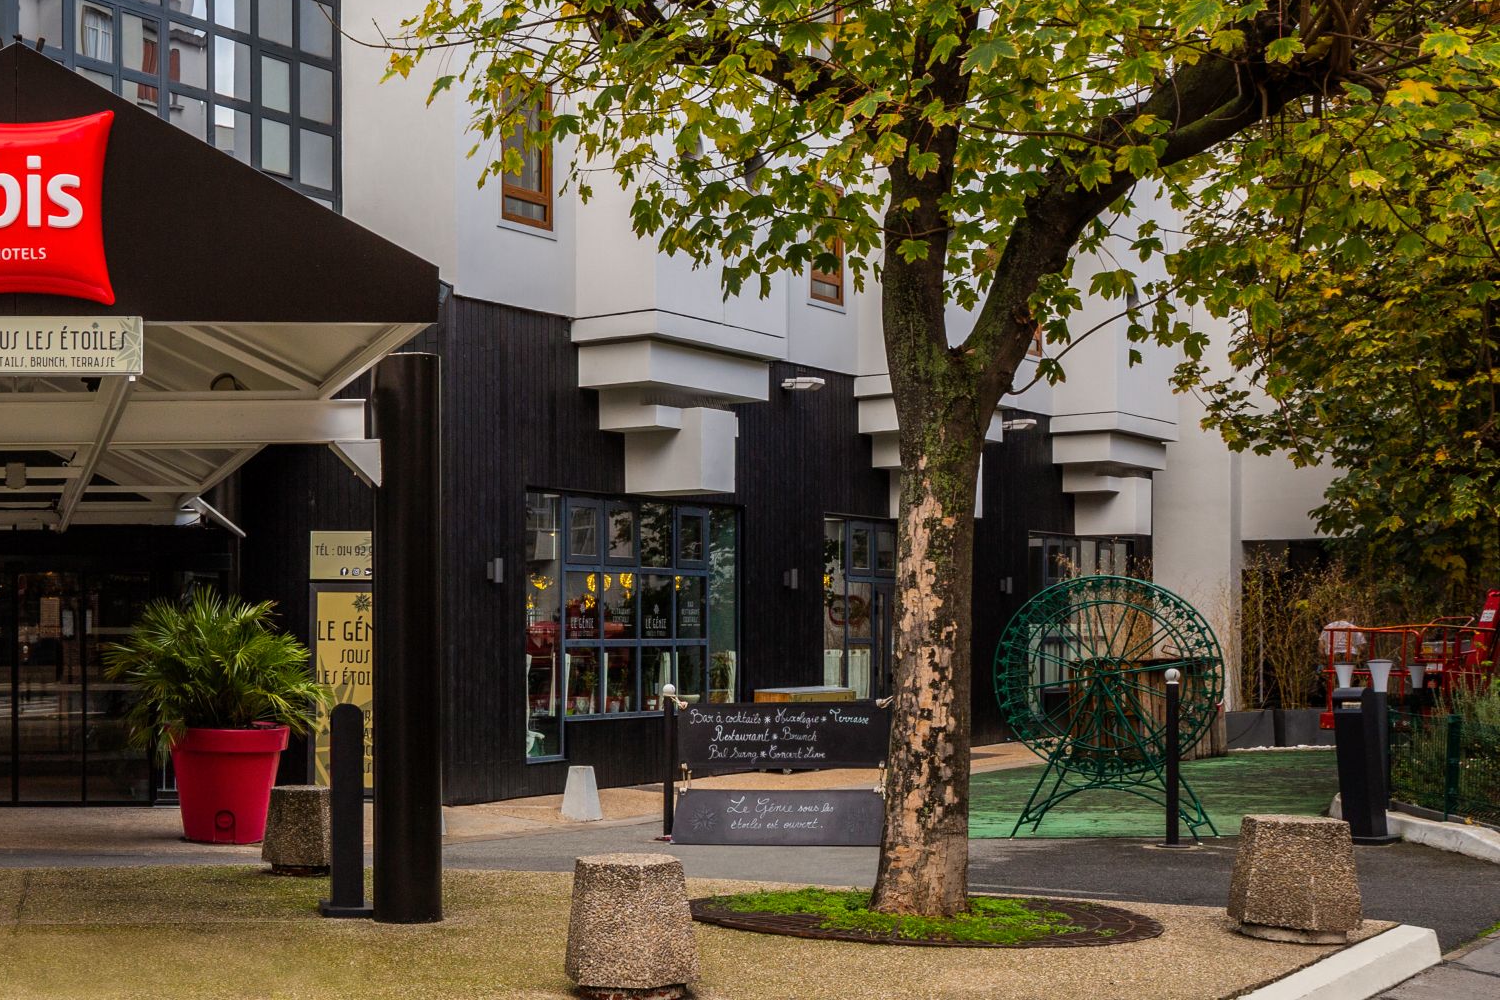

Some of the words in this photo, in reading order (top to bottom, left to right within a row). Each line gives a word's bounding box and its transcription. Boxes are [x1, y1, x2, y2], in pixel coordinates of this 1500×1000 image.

[26, 330, 53, 350] LES
[60, 325, 128, 350] ÉTOILES
[30, 356, 68, 368] BRUNCH,
[71, 356, 116, 368] TERRASSE
[315, 542, 329, 556] TÉL
[337, 546, 352, 556] 014
[318, 620, 336, 641] LE
[343, 616, 373, 641] GÉN
[340, 649, 370, 664] SOUS
[318, 670, 338, 684] LES
[342, 667, 371, 685] ÉTOI
[690, 708, 714, 724] Bar
[725, 711, 761, 724] cocktails
[775, 708, 820, 728] Mixologie
[829, 708, 870, 724] Terrasse
[711, 725, 770, 742] Restaurant
[780, 726, 818, 742] Brunch
[708, 744, 729, 760] Bal
[769, 744, 803, 759] Concert
[803, 746, 826, 759] Live
[726, 795, 750, 814] Le
[755, 798, 794, 819] Génie
[797, 804, 819, 813] sous
[821, 803, 834, 813] les
[766, 819, 779, 829] est
